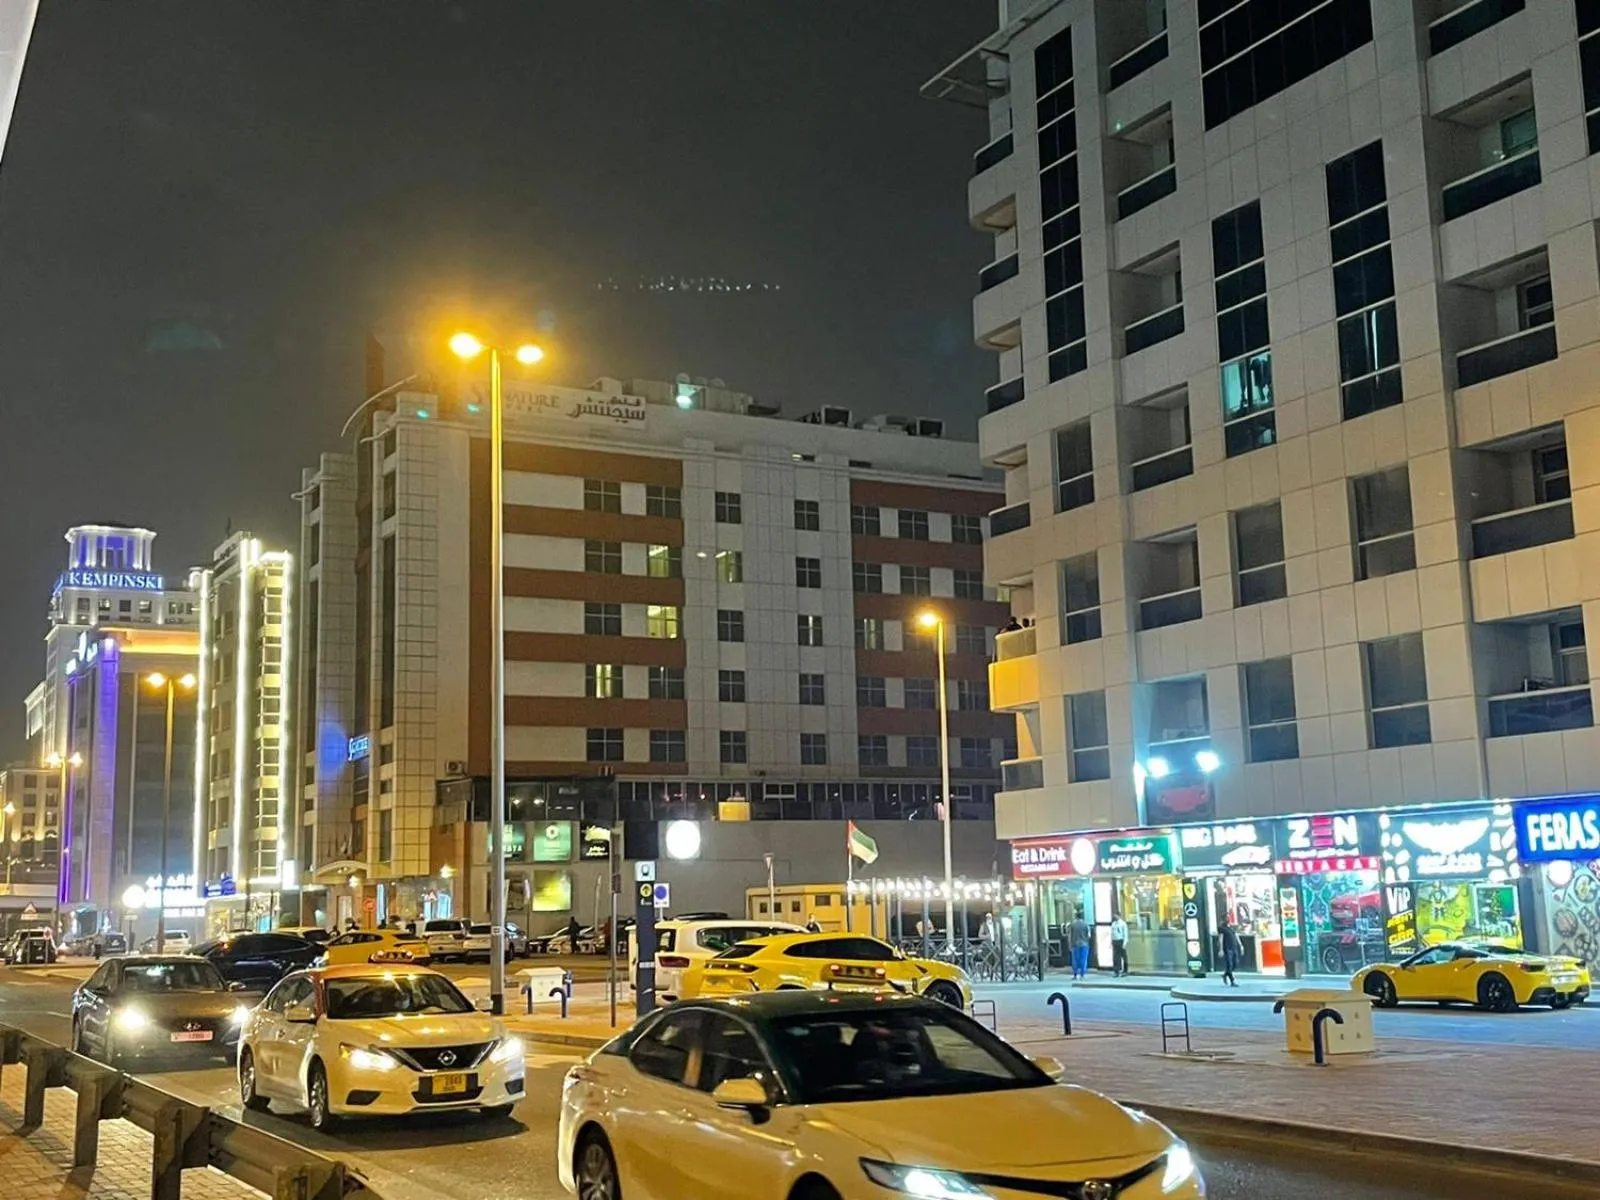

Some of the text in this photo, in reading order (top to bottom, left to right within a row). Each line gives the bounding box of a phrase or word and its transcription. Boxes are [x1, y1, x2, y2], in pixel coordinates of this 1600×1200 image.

[69, 572, 164, 589] KEMPINSKI
[1287, 815, 1358, 848] ZEN
[1526, 810, 1600, 852] FERAS
[1012, 848, 1031, 864] Eat
[1040, 846, 1066, 862] Drink
